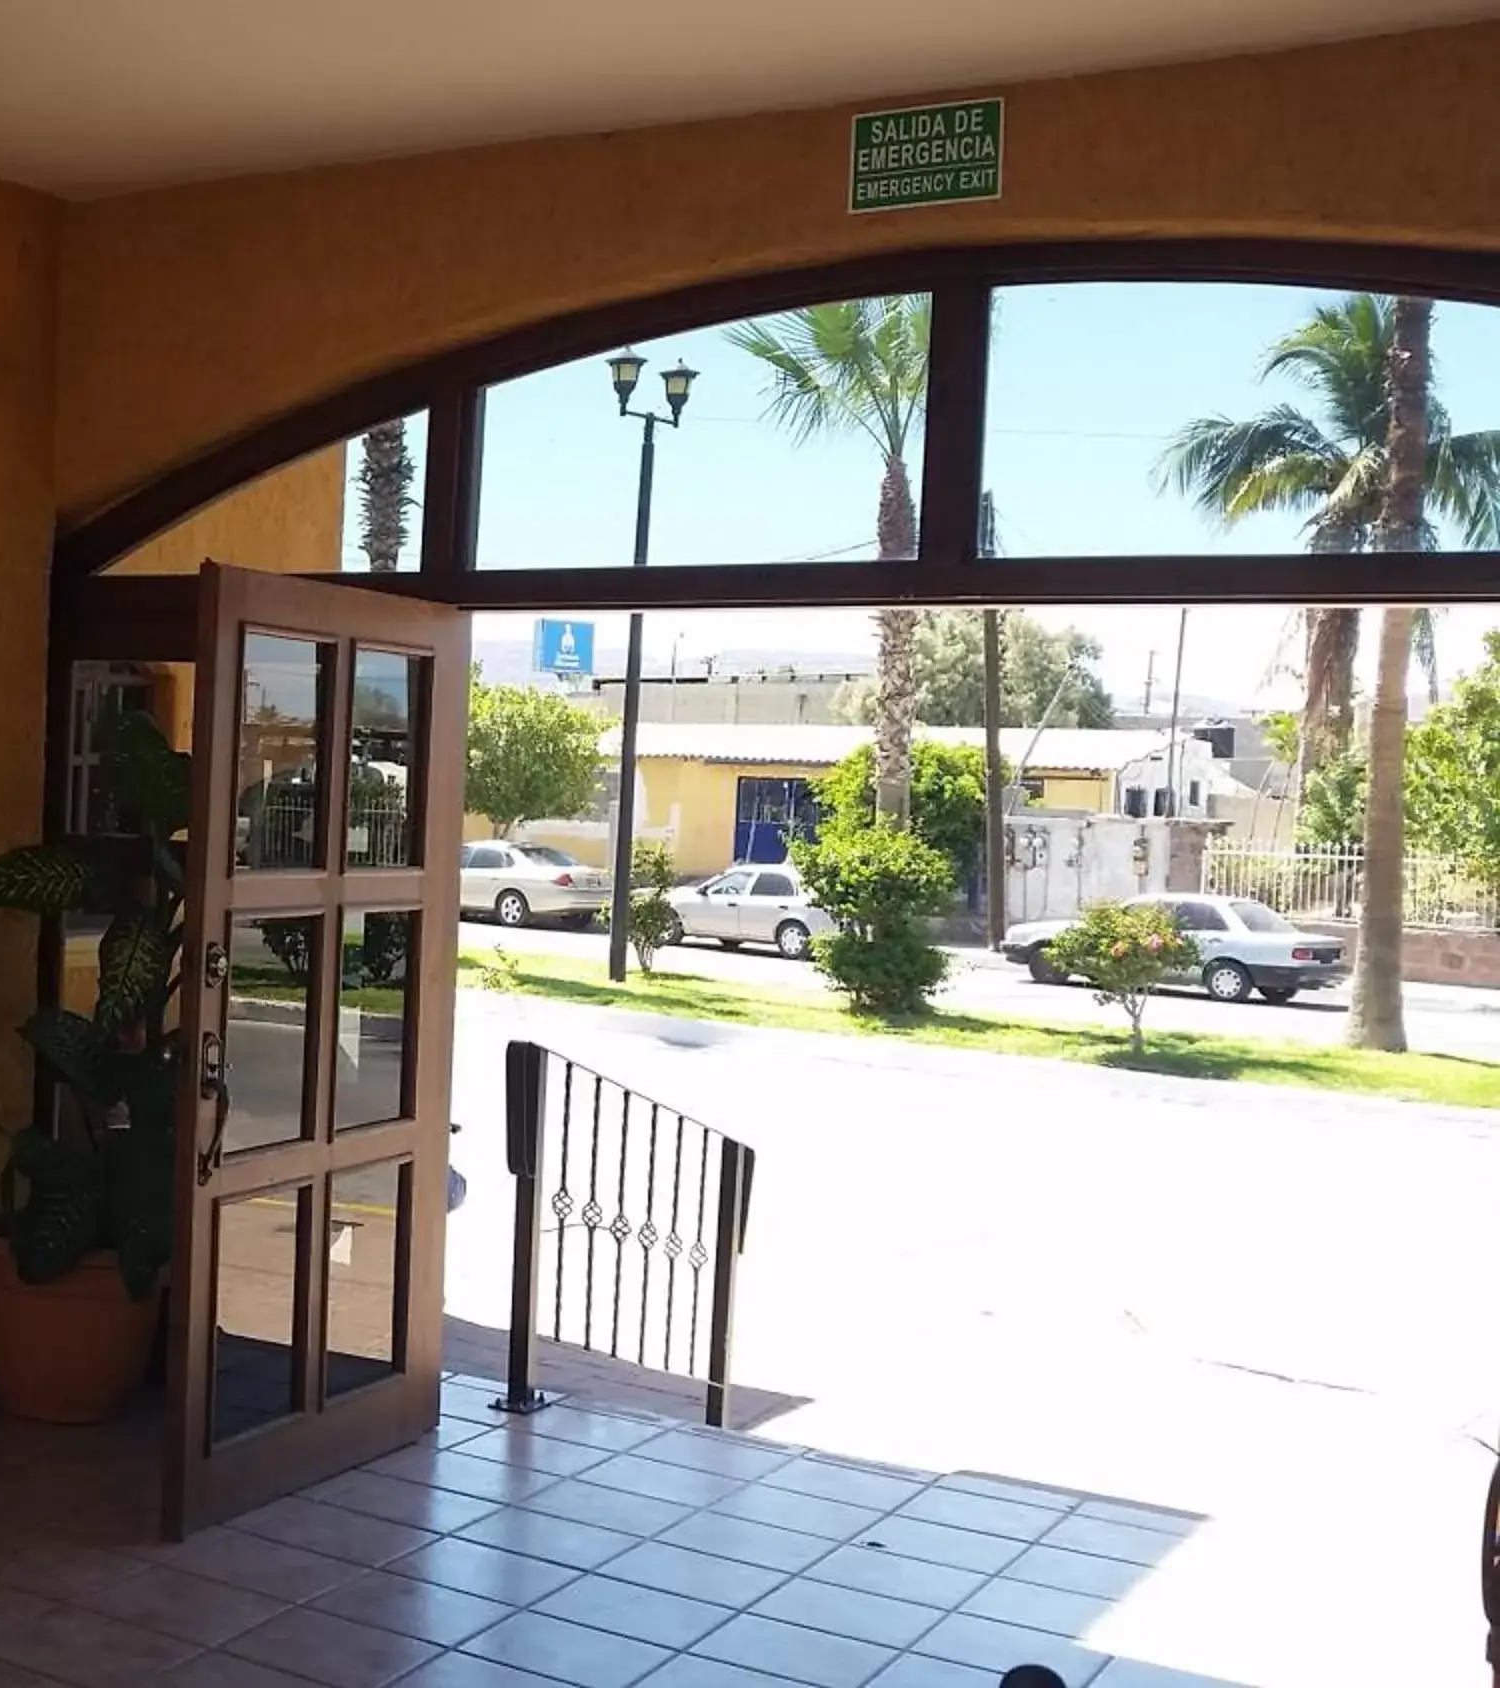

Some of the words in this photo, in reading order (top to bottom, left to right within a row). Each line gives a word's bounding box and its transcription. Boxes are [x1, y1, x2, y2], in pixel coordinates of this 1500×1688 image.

[871, 114, 946, 144] SALIDA
[954, 108, 985, 134] DE
[858, 135, 996, 172] EMERGENCIA
[856, 172, 956, 201] EMERGENCY
[959, 168, 997, 190] EXIT
